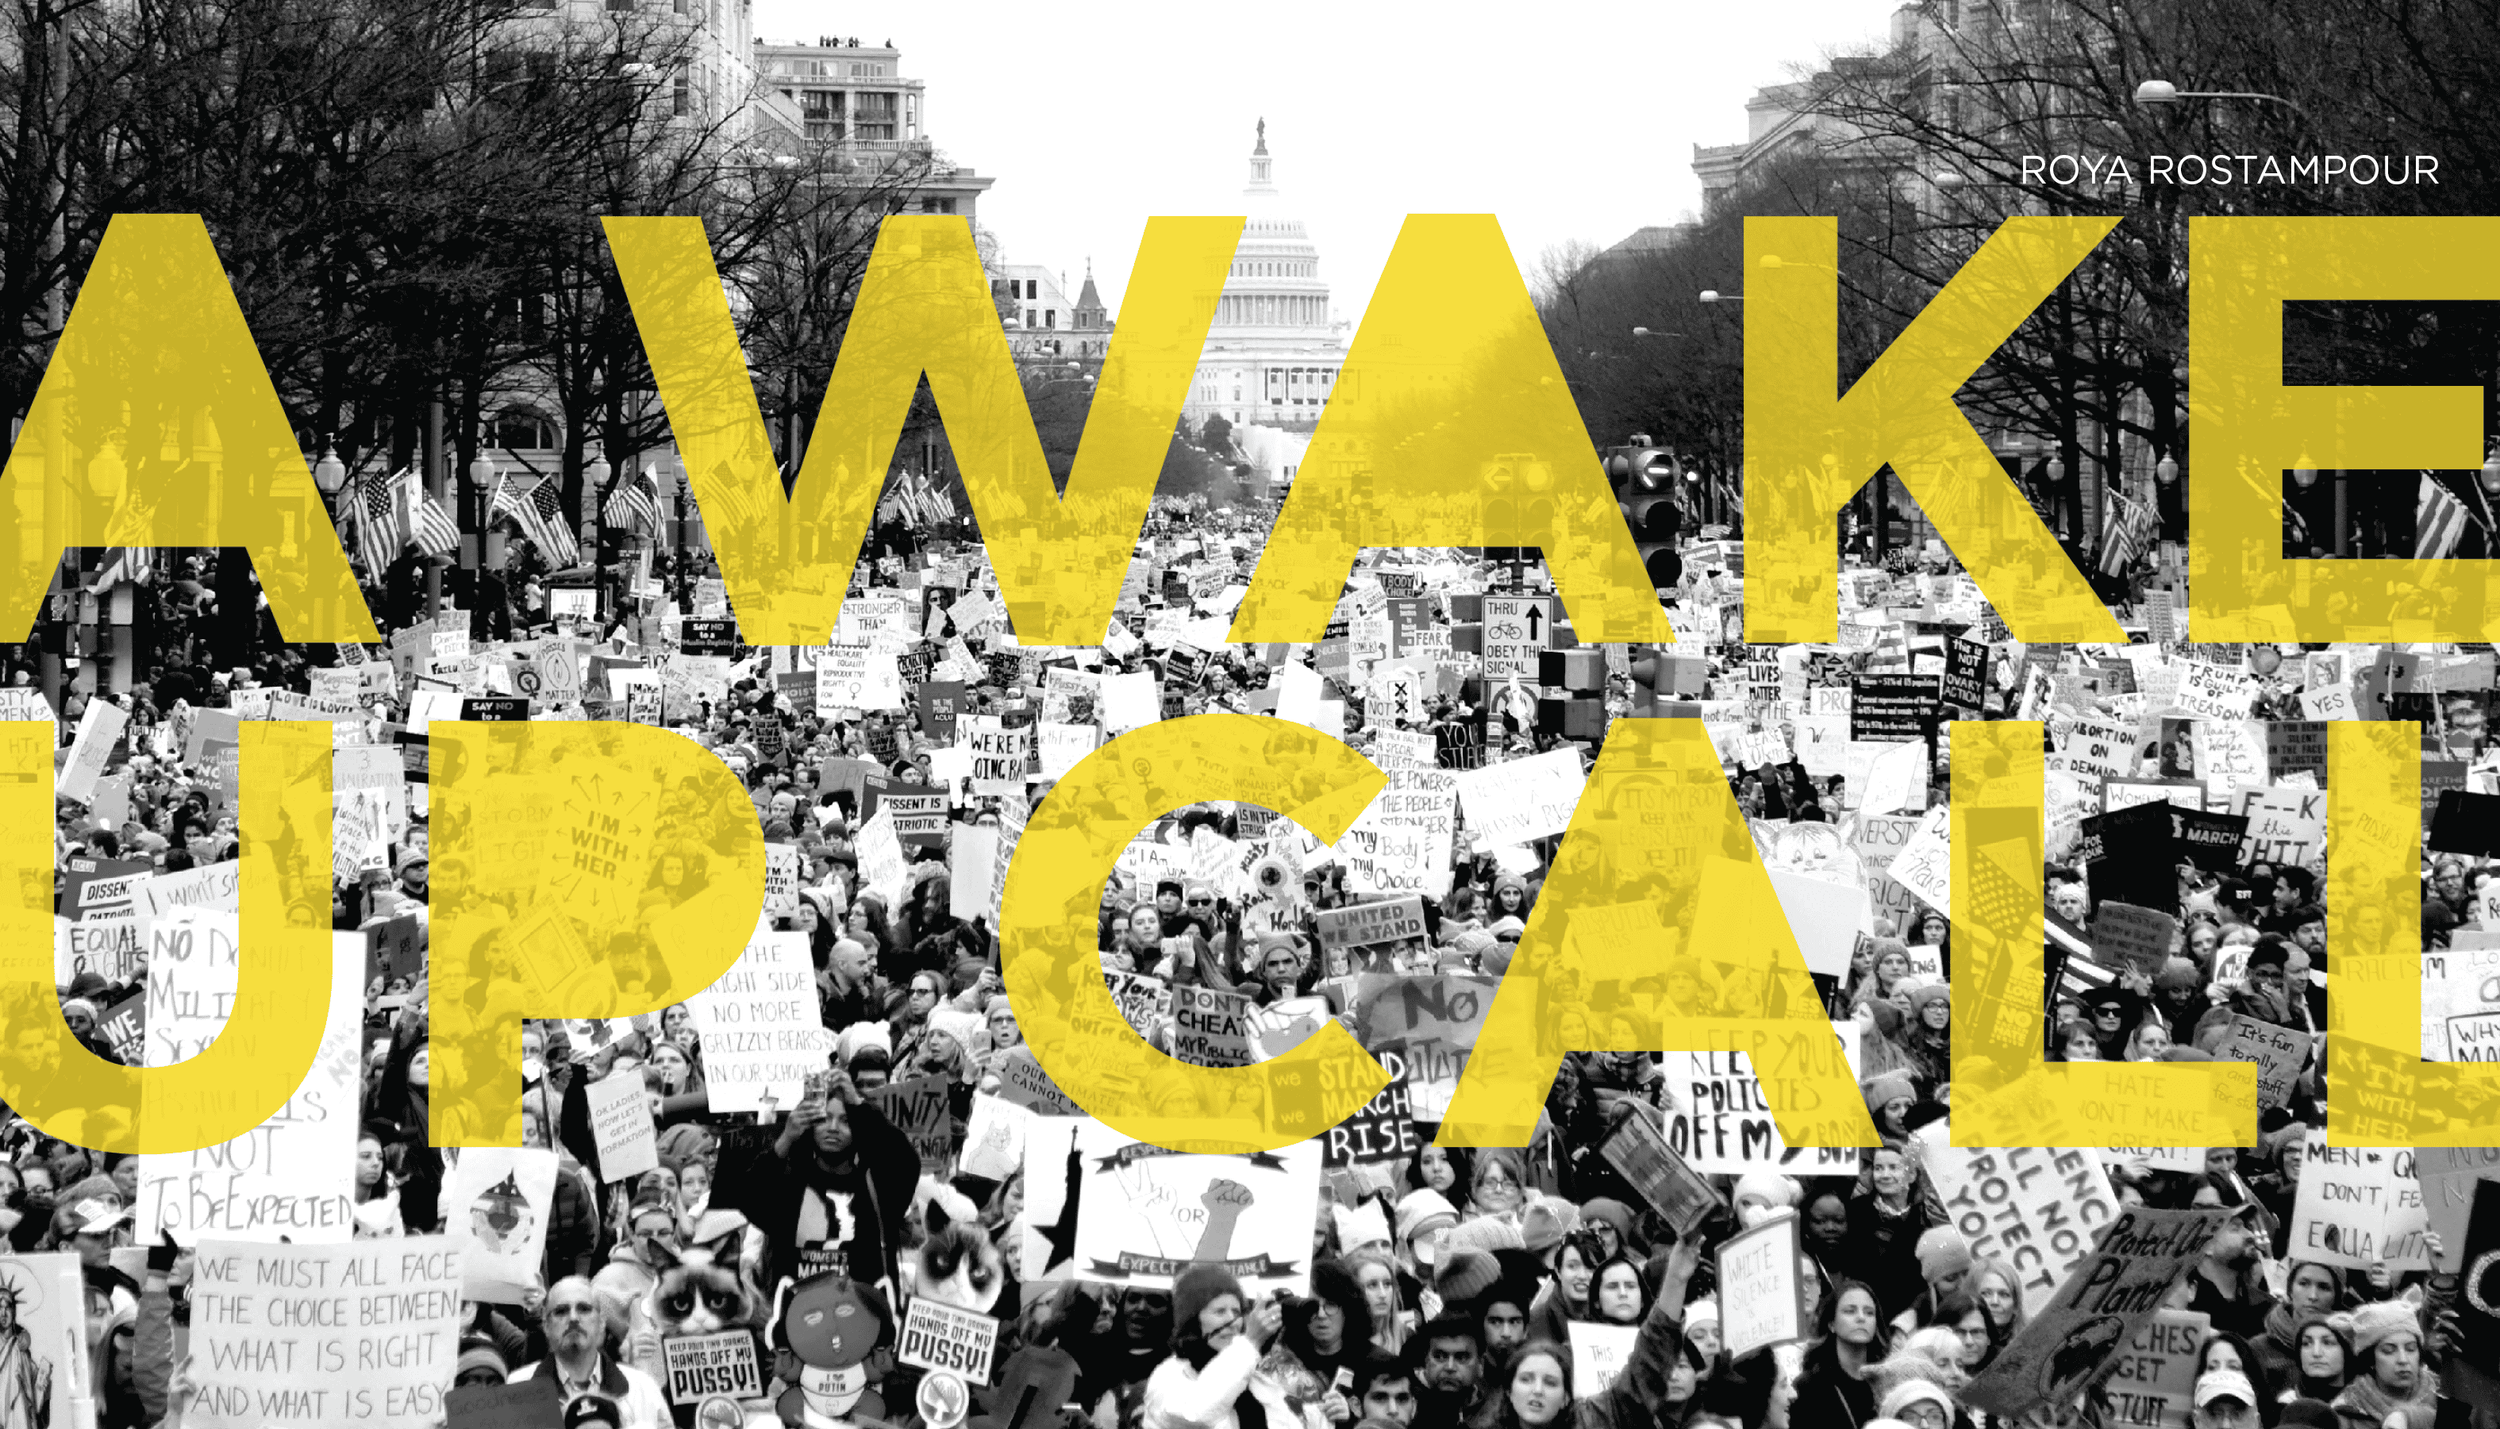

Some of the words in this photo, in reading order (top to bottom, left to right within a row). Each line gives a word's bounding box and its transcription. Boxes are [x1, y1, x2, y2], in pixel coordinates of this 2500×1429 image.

[1387, 575, 1415, 587] BODY
[842, 602, 901, 616] STRONGER
[1487, 602, 1518, 615] THRU
[692, 623, 709, 631] SAY
[710, 623, 725, 631] NO
[857, 618, 887, 631] THAN
[1416, 632, 1442, 645] FEAR
[1952, 638, 1972, 652] this
[1974, 646, 1984, 656] is
[1486, 645, 1517, 658] OBEY
[1746, 646, 1780, 663] BLACK
[1957, 654, 1982, 667] NOT
[822, 679, 846, 688] RIGHTS
[1748, 665, 1782, 683] LIVES
[1946, 674, 1982, 693] OVARY
[2188, 674, 2201, 688] IS
[2203, 679, 2250, 697] GUILTY
[2189, 662, 2249, 686] TRUMP
[545, 689, 576, 701] MATTER
[1748, 686, 1782, 701] MATTER
[1943, 686, 1981, 705] ACTION
[2207, 689, 2225, 700] OF
[2312, 692, 2345, 715] YES
[471, 701, 493, 711] SAY
[934, 713, 954, 721] ACLU
[1367, 701, 1390, 717] NOT
[1703, 711, 1722, 722] not
[1723, 707, 1744, 723] free
[2179, 693, 2246, 721] TREASON
[970, 731, 1014, 754] WE'RE
[2071, 720, 2138, 747] ABORTION
[1385, 743, 1416, 757] SPECIAL
[2089, 743, 2110, 759] ON
[2070, 759, 2119, 778] DEMAND
[866, 776, 888, 788] ACLU
[1383, 769, 1405, 791] THE
[1407, 770, 1443, 792] POWER
[2227, 775, 2237, 789] 5
[930, 797, 942, 809] IS
[1241, 791, 1273, 806] PLACE
[1381, 794, 1403, 813] THE
[1405, 795, 1443, 813] PEOPLE
[586, 809, 621, 836] I'M
[2255, 817, 2295, 836] this
[570, 826, 630, 862] WITH
[1351, 829, 1378, 854] my
[2187, 830, 2240, 845] MARCH
[1380, 835, 1418, 869] Body
[72, 859, 97, 873] ACLU
[571, 850, 618, 881] HER
[764, 866, 782, 876] I'M
[1350, 857, 1374, 881] my
[760, 875, 788, 886] WITH
[763, 885, 785, 896] HER
[1334, 905, 1405, 928] UNITED
[70, 924, 147, 954] EQUAL
[1323, 925, 1350, 944] WE
[1358, 919, 1421, 941] STAND
[152, 927, 194, 962] NO
[744, 944, 783, 964] THE
[2345, 956, 2447, 983] RACISM
[767, 971, 809, 992] SIDE
[1083, 964, 1120, 990] KEEP
[1120, 975, 1157, 1000] YOUR
[2004, 982, 2041, 1003] LOVE
[149, 968, 312, 1023] MILITARY
[1180, 988, 1246, 1015] DON'T
[713, 1002, 740, 1023] NO
[749, 1000, 803, 1022] MORE
[1999, 1003, 2034, 1029] NO
[101, 1008, 144, 1044] WE
[1071, 1017, 1100, 1036] OUT
[702, 1032, 772, 1055] GRIZZLY
[777, 1029, 824, 1052] BEARS
[2237, 1022, 2268, 1045] It's
[2269, 1031, 2295, 1054] fun
[1688, 1028, 1769, 1078] KEEP
[1772, 1030, 1854, 1080] YOUR
[2229, 1044, 2245, 1060] to
[2245, 1051, 2279, 1075] rally
[709, 1066, 728, 1086] IN
[732, 1064, 762, 1084] OUR
[1274, 1072, 1301, 1087] we
[1318, 1051, 1406, 1092] STAND
[2227, 1066, 2253, 1083] and
[2255, 1075, 2286, 1097] stuff
[2365, 1063, 2416, 1096] I'M
[1011, 1073, 1064, 1105] CANNOT
[1021, 1063, 1047, 1085] OUR
[1053, 1077, 1116, 1107] CLIMATE
[2103, 1070, 2168, 1100] HATE
[2212, 1082, 2233, 1104] for
[595, 1106, 611, 1119] OK
[612, 1090, 644, 1114] LADIES,
[1322, 1087, 1412, 1125] MARCH
[1691, 1076, 1823, 1118] POLICIES
[2357, 1088, 2416, 1122] WITH
[597, 1116, 619, 1131] NOW
[620, 1104, 644, 1123] LET'S
[609, 1125, 628, 1139] GET
[627, 1119, 638, 1131] IN
[2143, 1106, 2204, 1134] MAKE
[2351, 1113, 2410, 1143] HER
[193, 1124, 284, 1175] NOT
[1330, 1118, 1417, 1159] RISE
[1670, 1113, 1731, 1162] OFF
[1740, 1118, 1812, 1167] MY
[2106, 1132, 2190, 1162] GREAT!
[2306, 1142, 2361, 1168] MEN
[2322, 1182, 2383, 1205] DON'T
[1176, 1206, 1206, 1224] OR
[1954, 1130, 2056, 1291] PROTECT
[1945, 1183, 2001, 1263] YOU
[2096, 1212, 2175, 1258] Protect
[800, 1250, 849, 1264] WOMEN'S
[1120, 1256, 1178, 1274] EXPECT
[1726, 1241, 1774, 1283] WHITE
[198, 1257, 242, 1283] WE
[256, 1257, 330, 1289] MUST
[341, 1255, 386, 1287] ALL
[400, 1251, 461, 1283] FACE
[1732, 1275, 1783, 1312] SILENCE
[200, 1293, 252, 1325] THE
[266, 1296, 349, 1328] CHOICE
[358, 1289, 459, 1326] BETWEEN
[908, 1314, 948, 1337] HANDS
[950, 1325, 970, 1342] OFF
[974, 1331, 992, 1347] MY
[209, 1332, 298, 1373] WHAT
[315, 1338, 345, 1372] IS
[357, 1331, 441, 1369] RIGHT
[670, 1351, 708, 1368] HANDS
[710, 1349, 731, 1365] OFF
[735, 1347, 752, 1362] MY
[904, 1329, 988, 1377] PUSSY!
[1589, 1345, 1615, 1363] THIS
[673, 1363, 757, 1398] PUSSY!
[2114, 1356, 2167, 1383] GET
[818, 1383, 846, 1392] PUTIN
[191, 1385, 249, 1417] AND
[257, 1390, 329, 1420] WHAT
[344, 1389, 372, 1419] IS
[385, 1380, 449, 1417] EASY
[2101, 1391, 2169, 1426] STUFF
